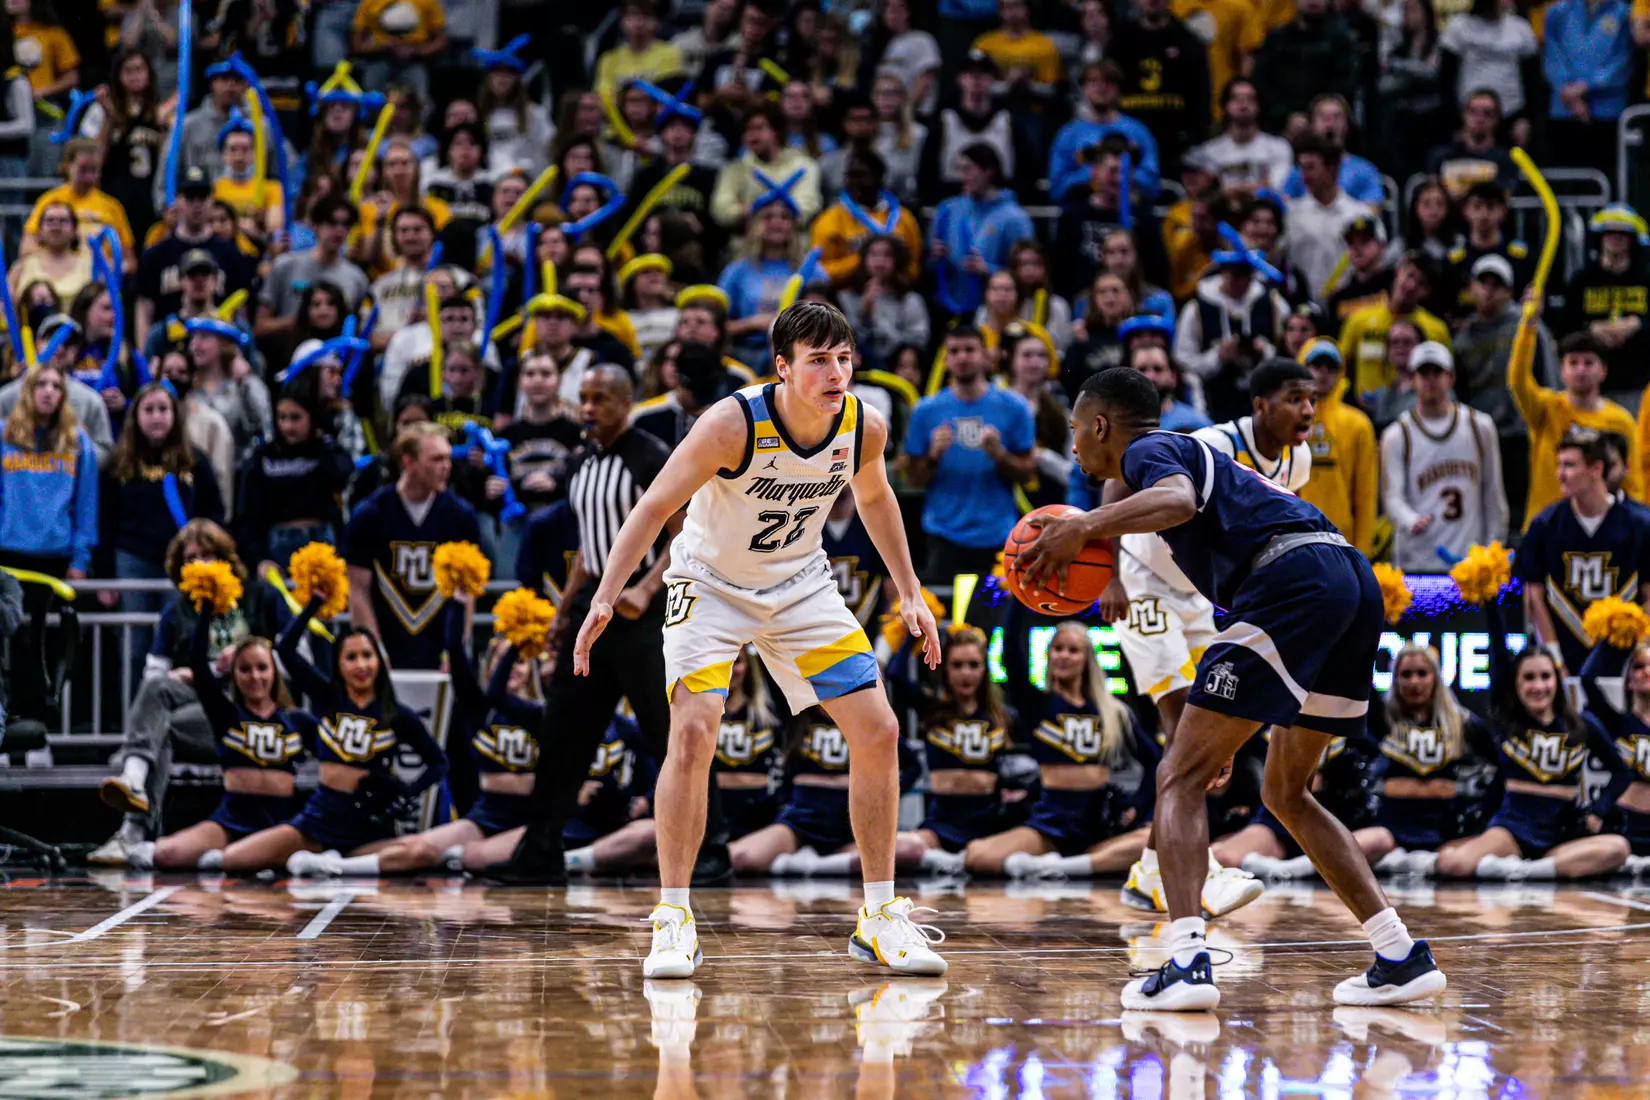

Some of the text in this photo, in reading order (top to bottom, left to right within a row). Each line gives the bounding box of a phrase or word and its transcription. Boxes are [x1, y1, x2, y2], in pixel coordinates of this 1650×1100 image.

[129, 145, 152, 178] 3
[745, 474, 846, 506] Marquette
[1441, 486, 1463, 521] 3
[748, 505, 819, 552] 22
[1564, 552, 1618, 600] MU
[666, 581, 697, 627] MU
[1128, 597, 1167, 635] MU
[244, 723, 286, 763] MU
[338, 714, 375, 759] MU
[495, 726, 534, 766] MU
[717, 722, 752, 761] MU
[811, 725, 849, 767] MU
[953, 721, 989, 761] MU
[1060, 715, 1102, 756] MU
[1407, 728, 1445, 766] MU
[1528, 730, 1568, 775] MU
